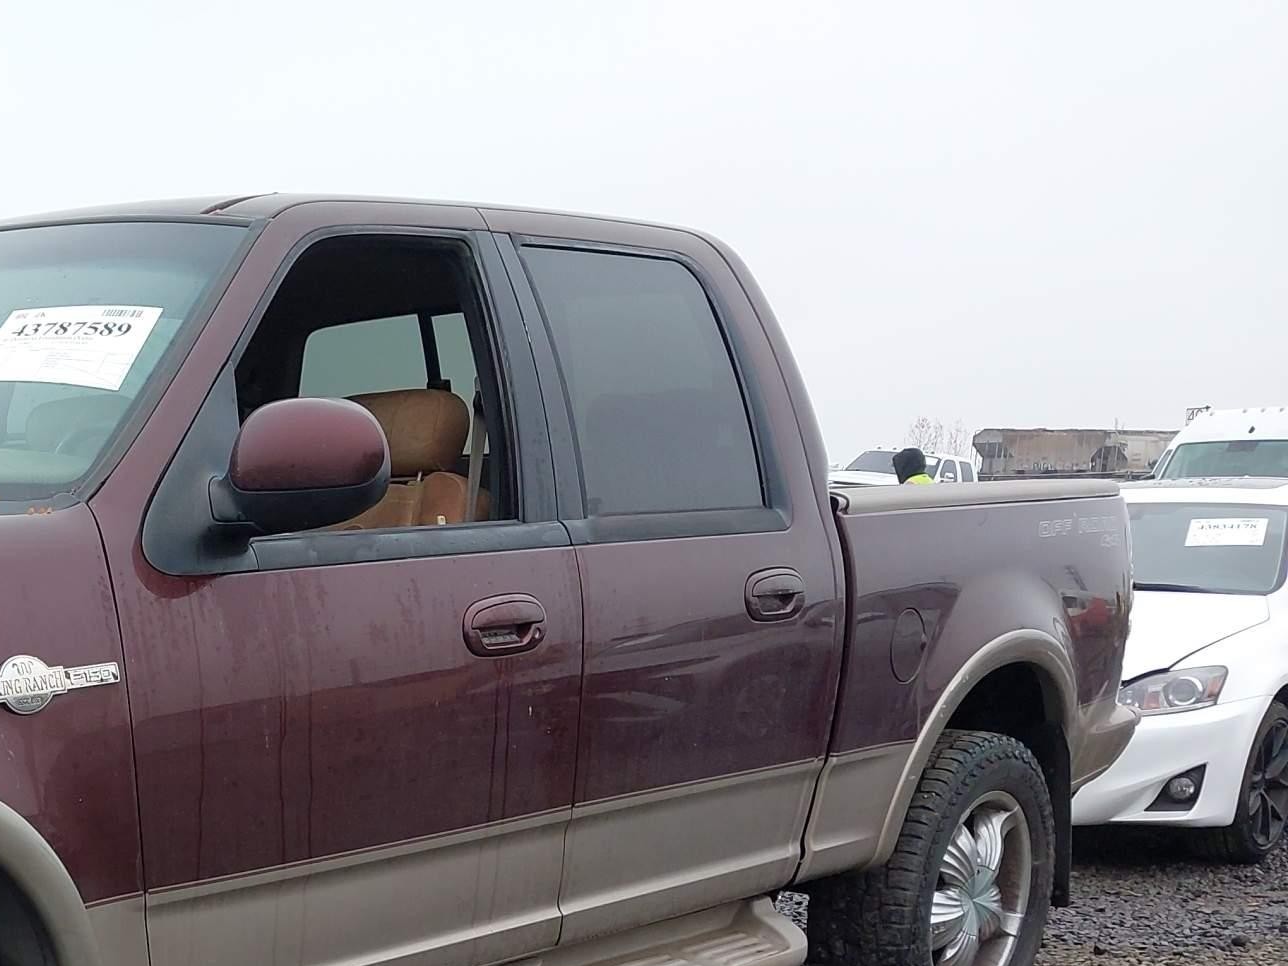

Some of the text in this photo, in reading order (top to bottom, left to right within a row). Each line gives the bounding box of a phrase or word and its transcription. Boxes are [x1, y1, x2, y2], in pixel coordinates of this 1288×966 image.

[11, 321, 133, 337] 43787589
[1039, 518, 1072, 538] OFF
[25, 670, 65, 693] RANCH
